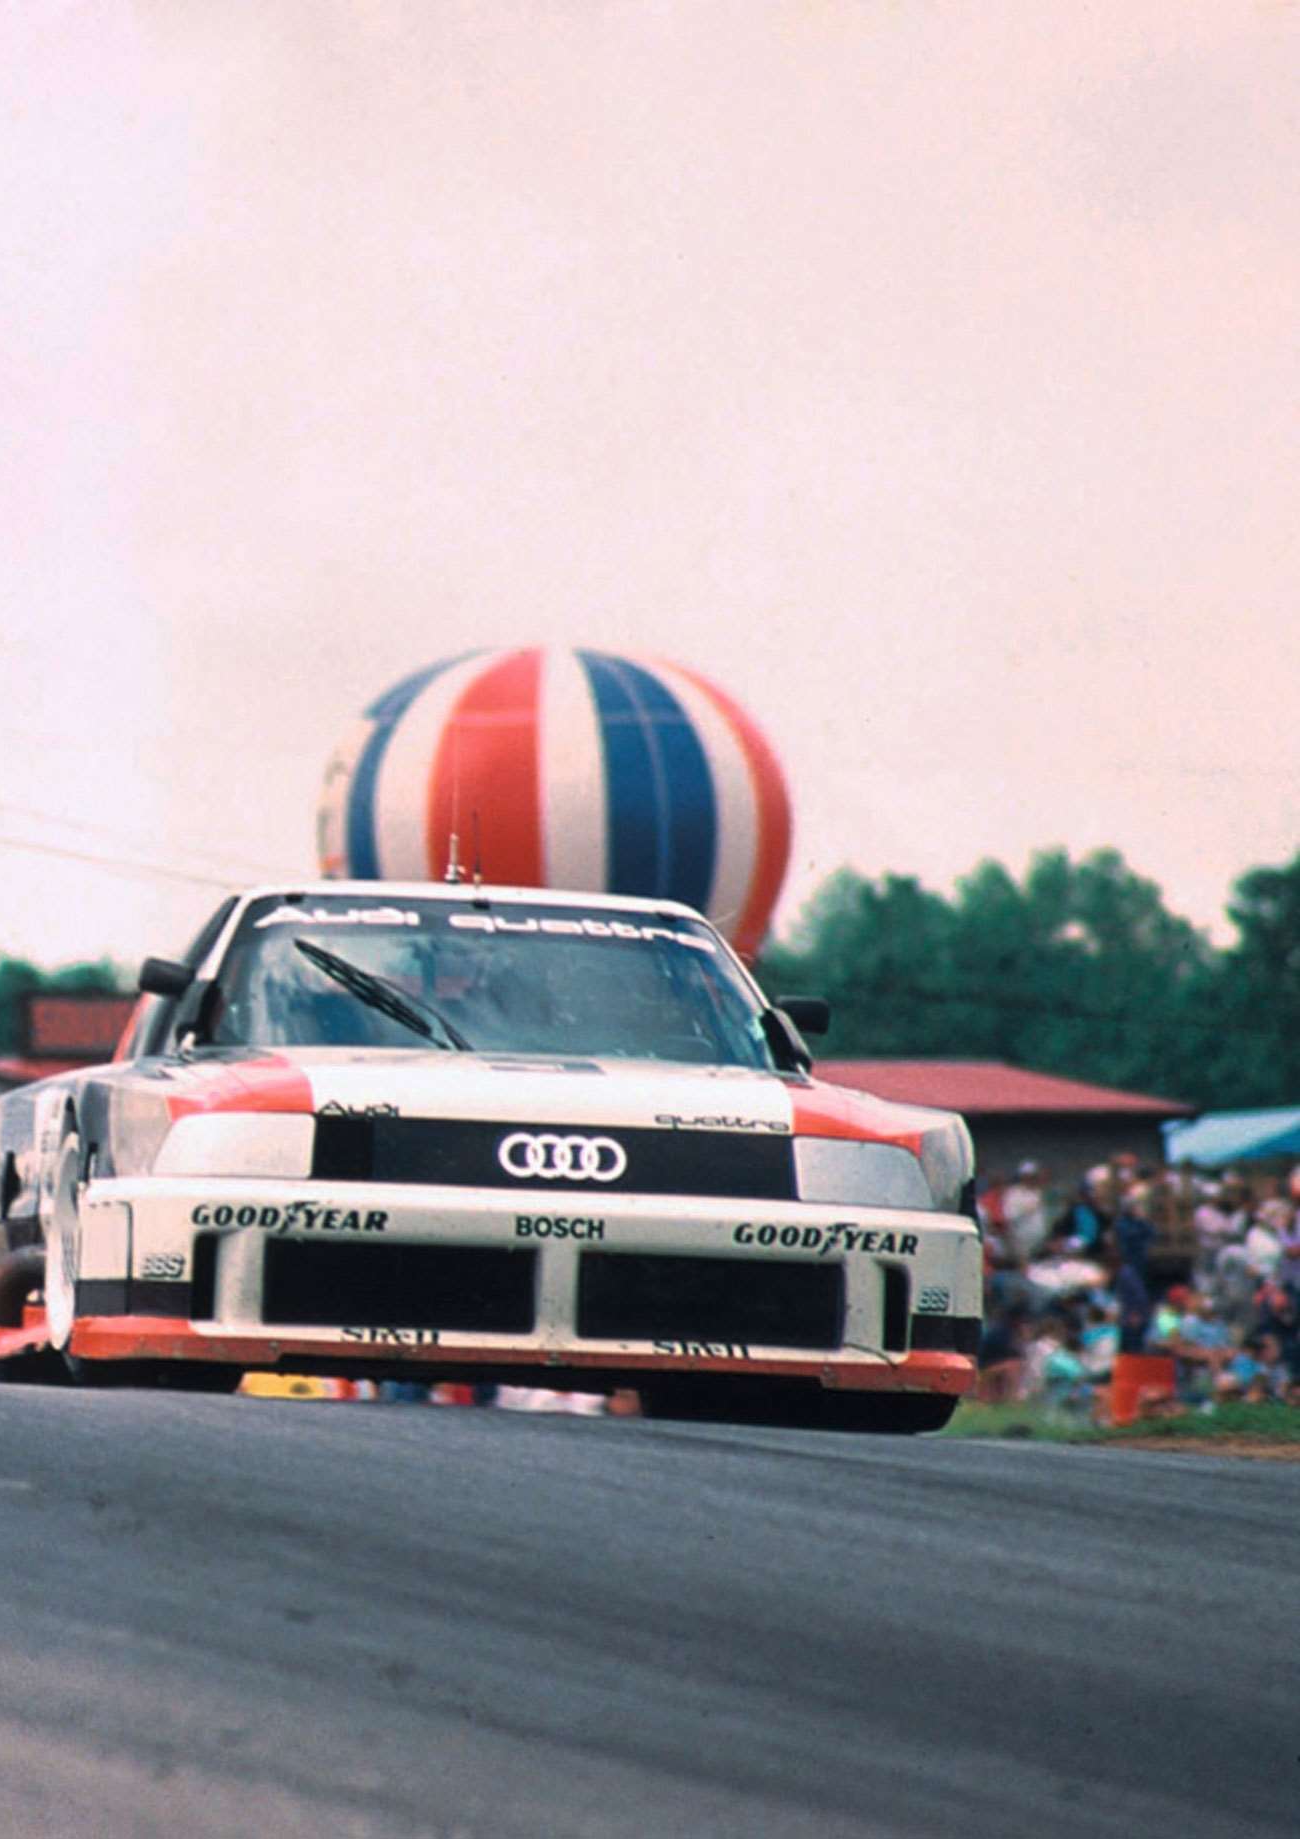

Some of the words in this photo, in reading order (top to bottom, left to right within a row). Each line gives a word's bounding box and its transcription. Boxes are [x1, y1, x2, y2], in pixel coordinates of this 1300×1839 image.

[254, 907, 420, 928] Audi
[448, 914, 718, 953] quattro
[317, 1100, 400, 1118] Audi
[654, 1115, 790, 1132] quattro
[191, 1201, 388, 1234] GOODYEAR
[516, 1216, 605, 1239] BOSCH
[733, 1223, 919, 1256] GOODYEAR
